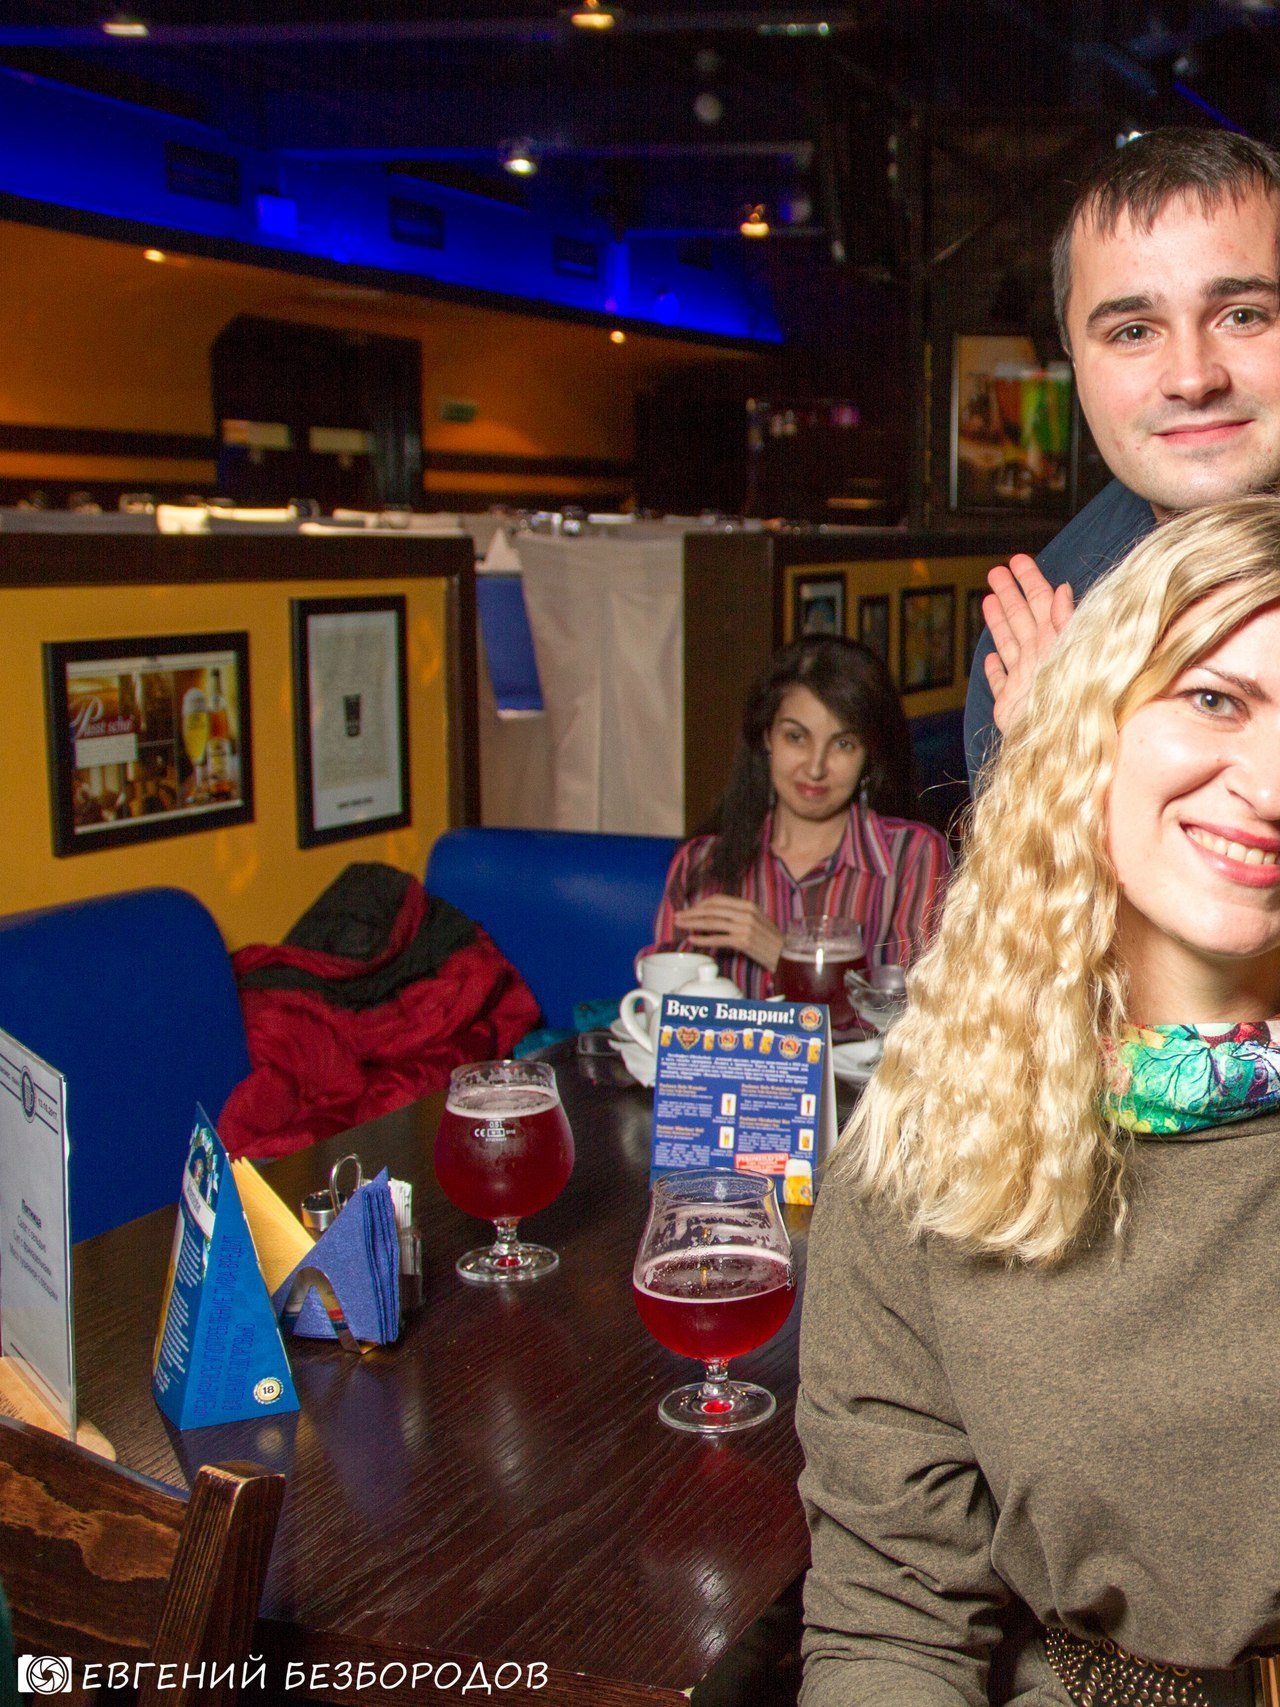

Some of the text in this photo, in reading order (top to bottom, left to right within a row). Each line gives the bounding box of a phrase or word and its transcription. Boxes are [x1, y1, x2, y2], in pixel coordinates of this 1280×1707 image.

[666, 1000, 709, 1021] Вкус
[715, 1003, 796, 1025] Баварии!
[218, 1235, 244, 1269] ВРЕДИТ
[214, 1271, 237, 1294] ПИВА
[262, 1385, 275, 1395] 18
